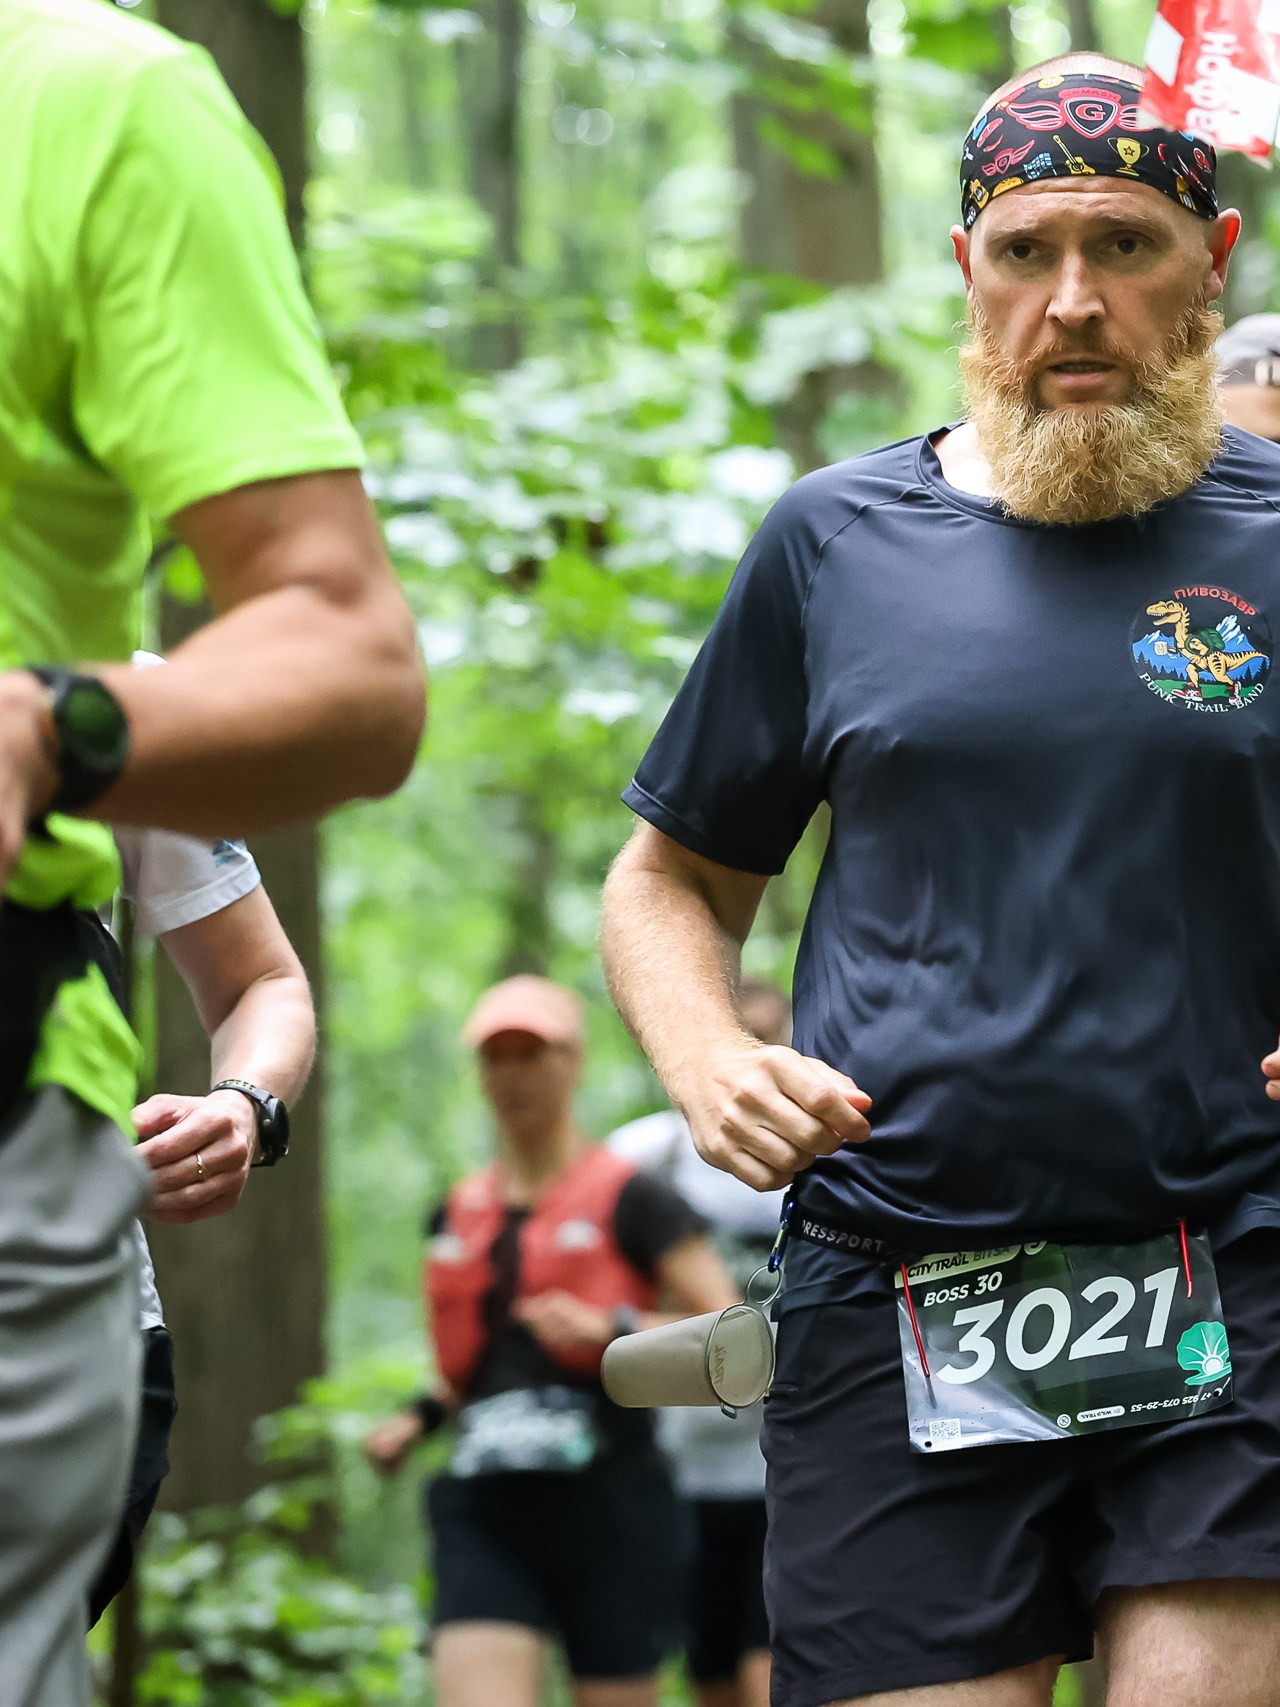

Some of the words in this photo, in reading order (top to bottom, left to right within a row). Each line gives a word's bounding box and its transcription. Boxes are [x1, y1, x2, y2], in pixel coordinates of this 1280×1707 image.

[1075, 103, 1106, 121] G
[1173, 586, 1257, 616] ПИВОЗАВР
[1138, 672, 1179, 704] PUNK
[1184, 700, 1229, 713] TRAIL
[1234, 682, 1264, 710] BAND
[923, 1284, 970, 1307] BOSS
[974, 1271, 1003, 1295] 30
[935, 1267, 1179, 1385] 3021
[1130, 1398, 1180, 1413] 073-29-53
[1181, 1395, 1200, 1405] 925
[1200, 1392, 1212, 1402] +7
